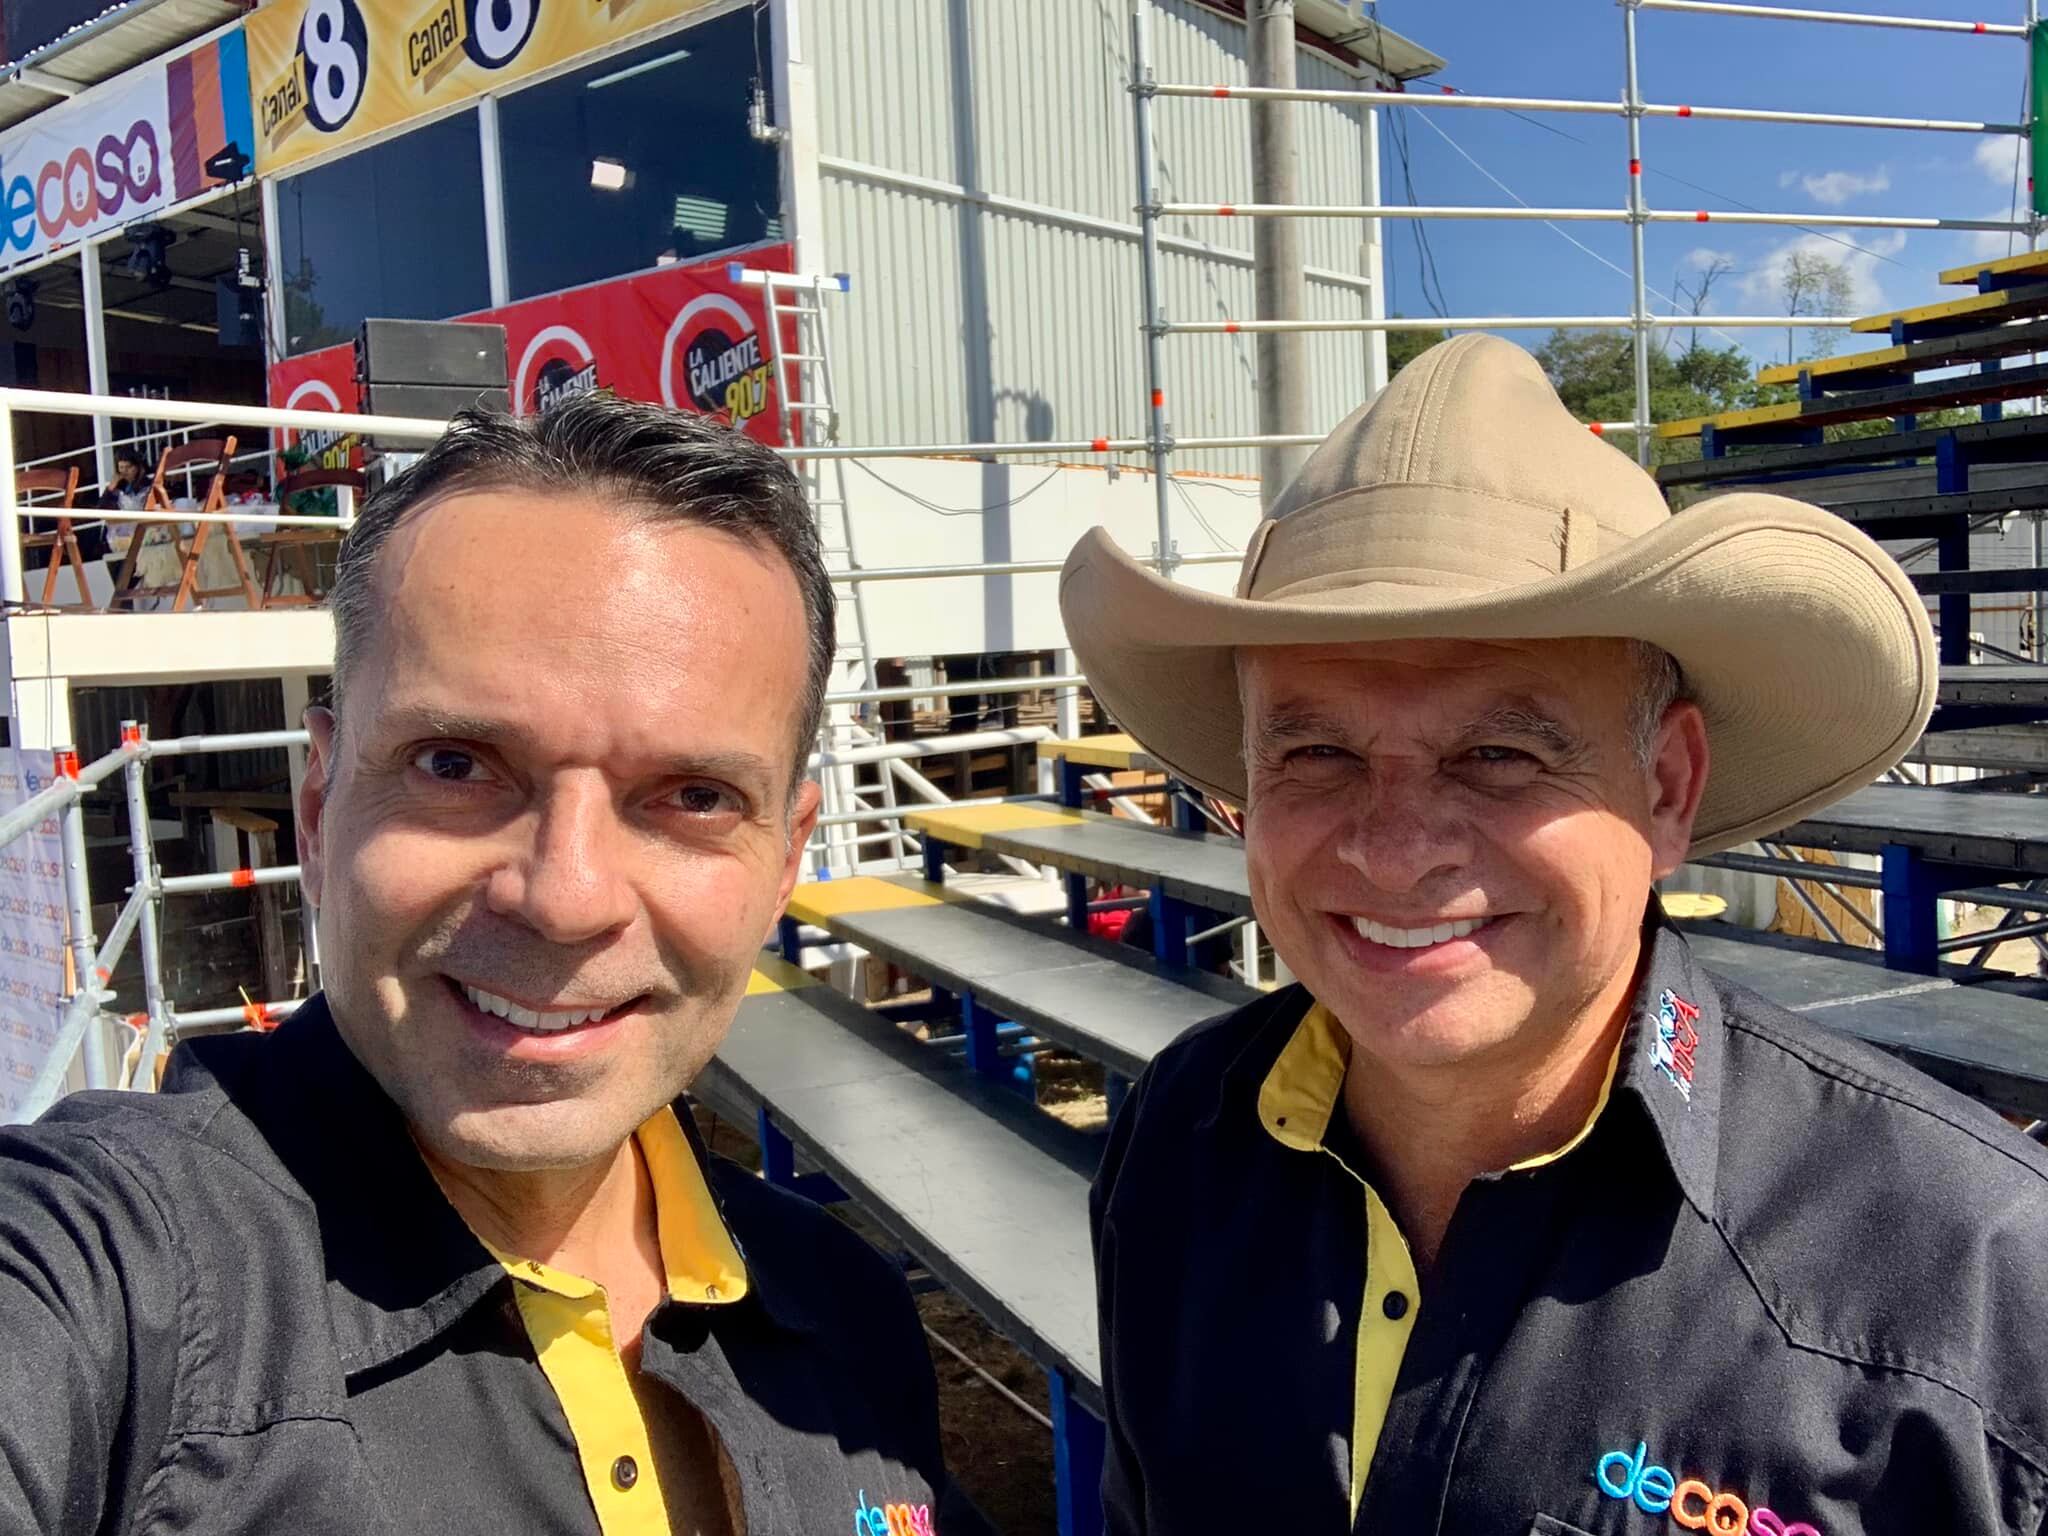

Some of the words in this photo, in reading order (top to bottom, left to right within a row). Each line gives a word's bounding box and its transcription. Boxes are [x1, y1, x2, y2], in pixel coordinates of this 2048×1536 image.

[261, 65, 303, 137] Canal
[303, 0, 360, 125] 8
[408, 0, 459, 78] Canal
[0, 119, 162, 256] ecasa
[690, 347, 704, 369] LA
[690, 334, 761, 397] CALIENTE
[725, 365, 768, 425] 90.7
